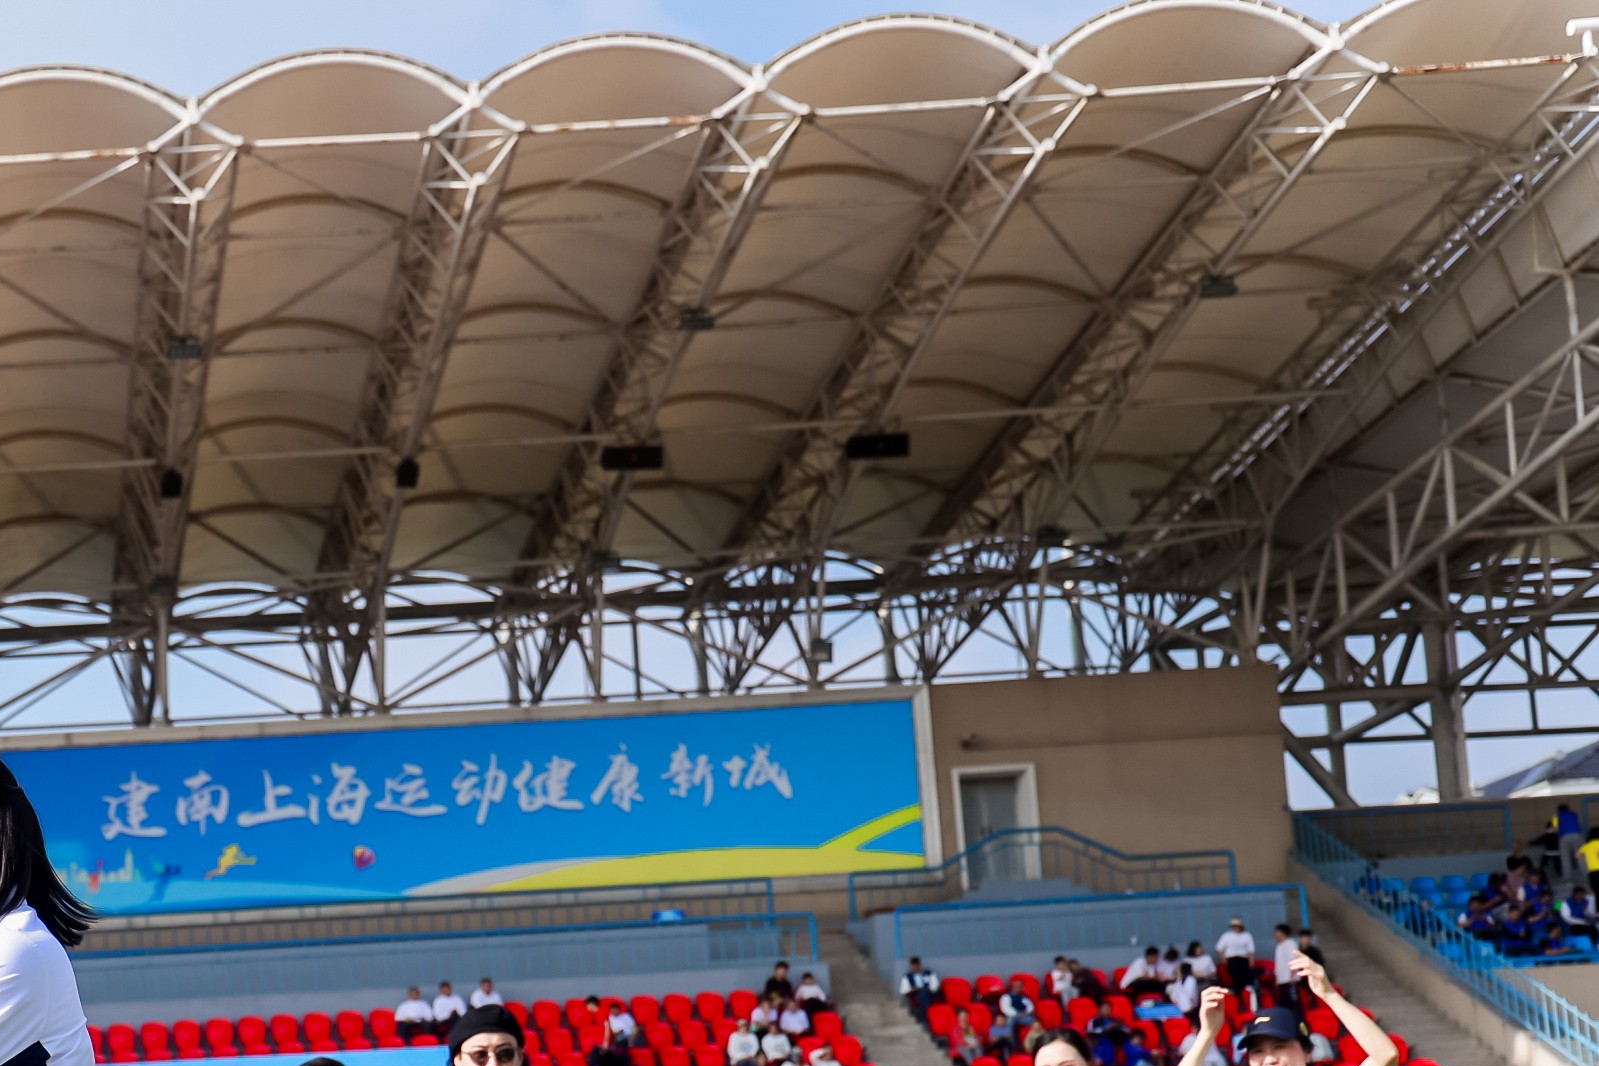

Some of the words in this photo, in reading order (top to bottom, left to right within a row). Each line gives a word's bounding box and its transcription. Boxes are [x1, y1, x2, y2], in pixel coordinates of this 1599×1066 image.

[100, 742, 793, 841] 建南上海运动健康新城
